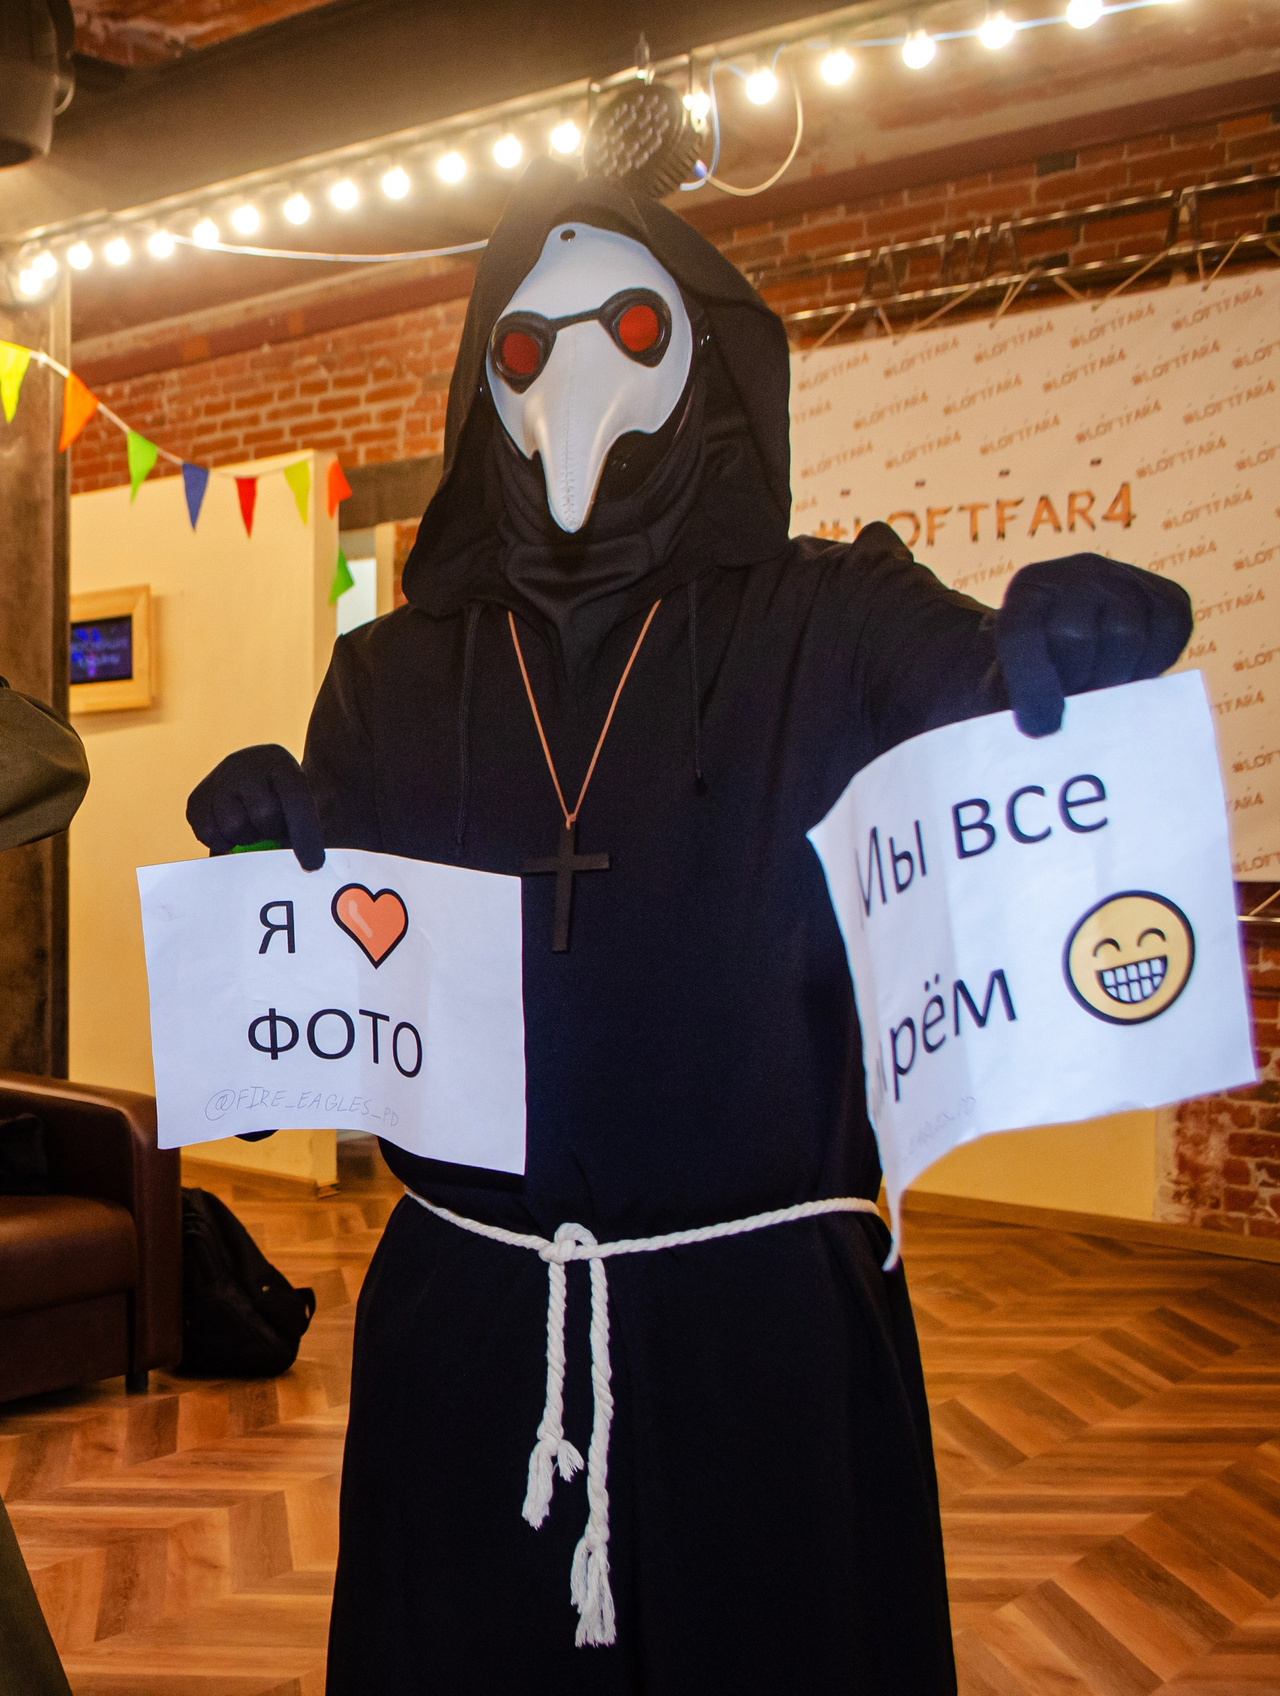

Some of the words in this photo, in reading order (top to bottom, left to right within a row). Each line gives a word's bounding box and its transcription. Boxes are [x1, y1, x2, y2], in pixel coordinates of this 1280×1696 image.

[951, 773, 1108, 860] все
[258, 900, 296, 955] Я
[247, 1008, 423, 1079] ФОТО
[873, 968, 1018, 1113] рём
